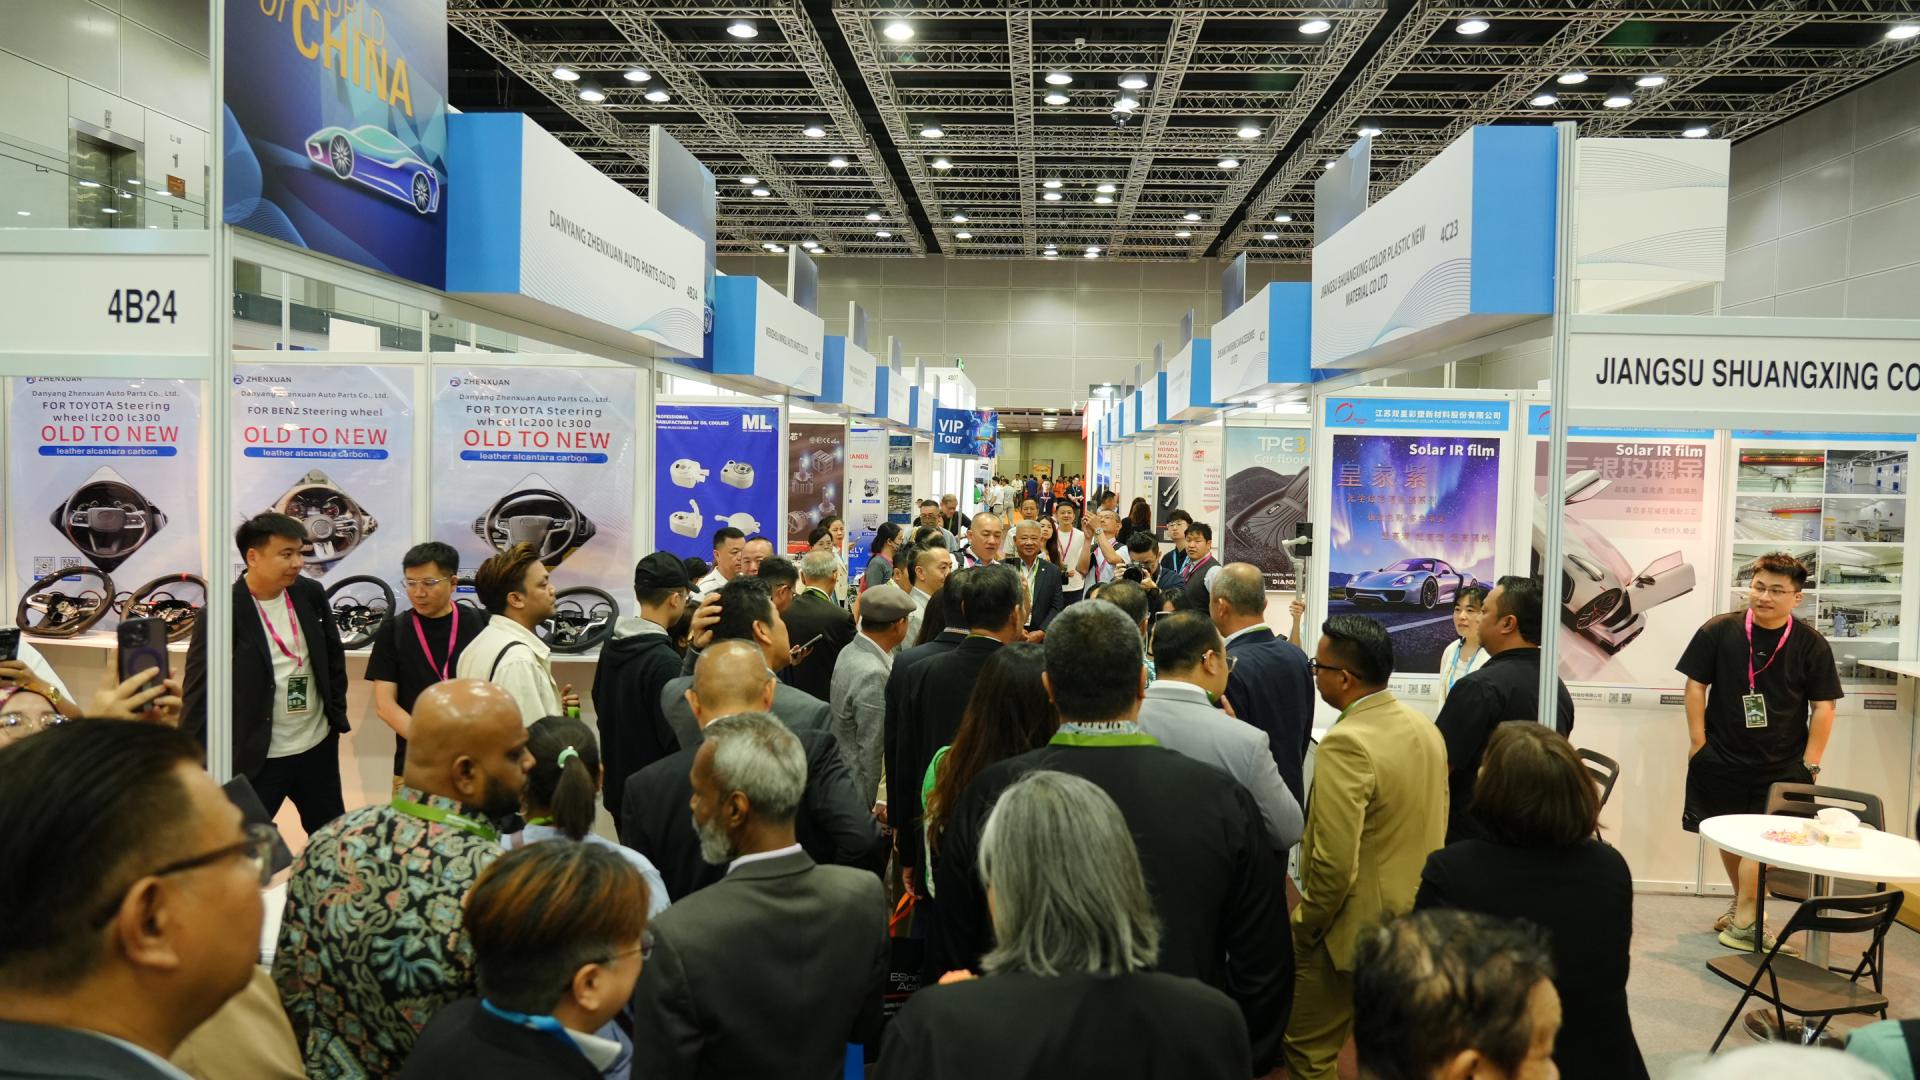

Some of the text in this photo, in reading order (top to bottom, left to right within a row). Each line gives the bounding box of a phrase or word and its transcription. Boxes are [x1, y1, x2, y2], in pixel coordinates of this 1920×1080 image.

[293, 0, 412, 116] CHINA
[1440, 219, 1459, 244] 4C23
[550, 210, 676, 290] DANYANG ZHENXUAN AUTO PARTS CO LTD
[1369, 249, 1386, 272] COLOR
[1388, 235, 1411, 263] PLASTIC
[1412, 224, 1426, 248] NEW
[686, 285, 698, 300] 4B24
[1345, 273, 1388, 306] MATERIAL CO LTD
[108, 289, 178, 324] 4B24
[1596, 357, 1704, 387] JIANGSU
[1712, 358, 1878, 390] SHUANGXING
[42, 402, 170, 412] FOR TOYOTA Steering
[302, 408, 347, 417] Steering
[466, 405, 602, 418] FOR TOYOTA Steering
[53, 414, 161, 422] wheel lc200 lc300
[477, 418, 591, 428] wheel lc200 lc300
[742, 414, 772, 430] ML
[939, 419, 964, 433] VIP
[42, 426, 179, 442] OLD TO NEW
[244, 426, 387, 445] OLD TO NEW
[464, 430, 610, 449] OLD TO NEW
[938, 432, 962, 444] Tour
[56, 447, 85, 455] leather
[263, 449, 369, 458] leather alcantara carbon
[480, 452, 511, 460] leather
[1409, 444, 1494, 457] Solar IR film
[1616, 444, 1703, 458] Solar IR film
[1255, 454, 1274, 464] Car
[1278, 454, 1304, 464] floor
[1338, 462, 1428, 489] 皇家紫
[1567, 457, 1704, 480] 三银玫瑰金
